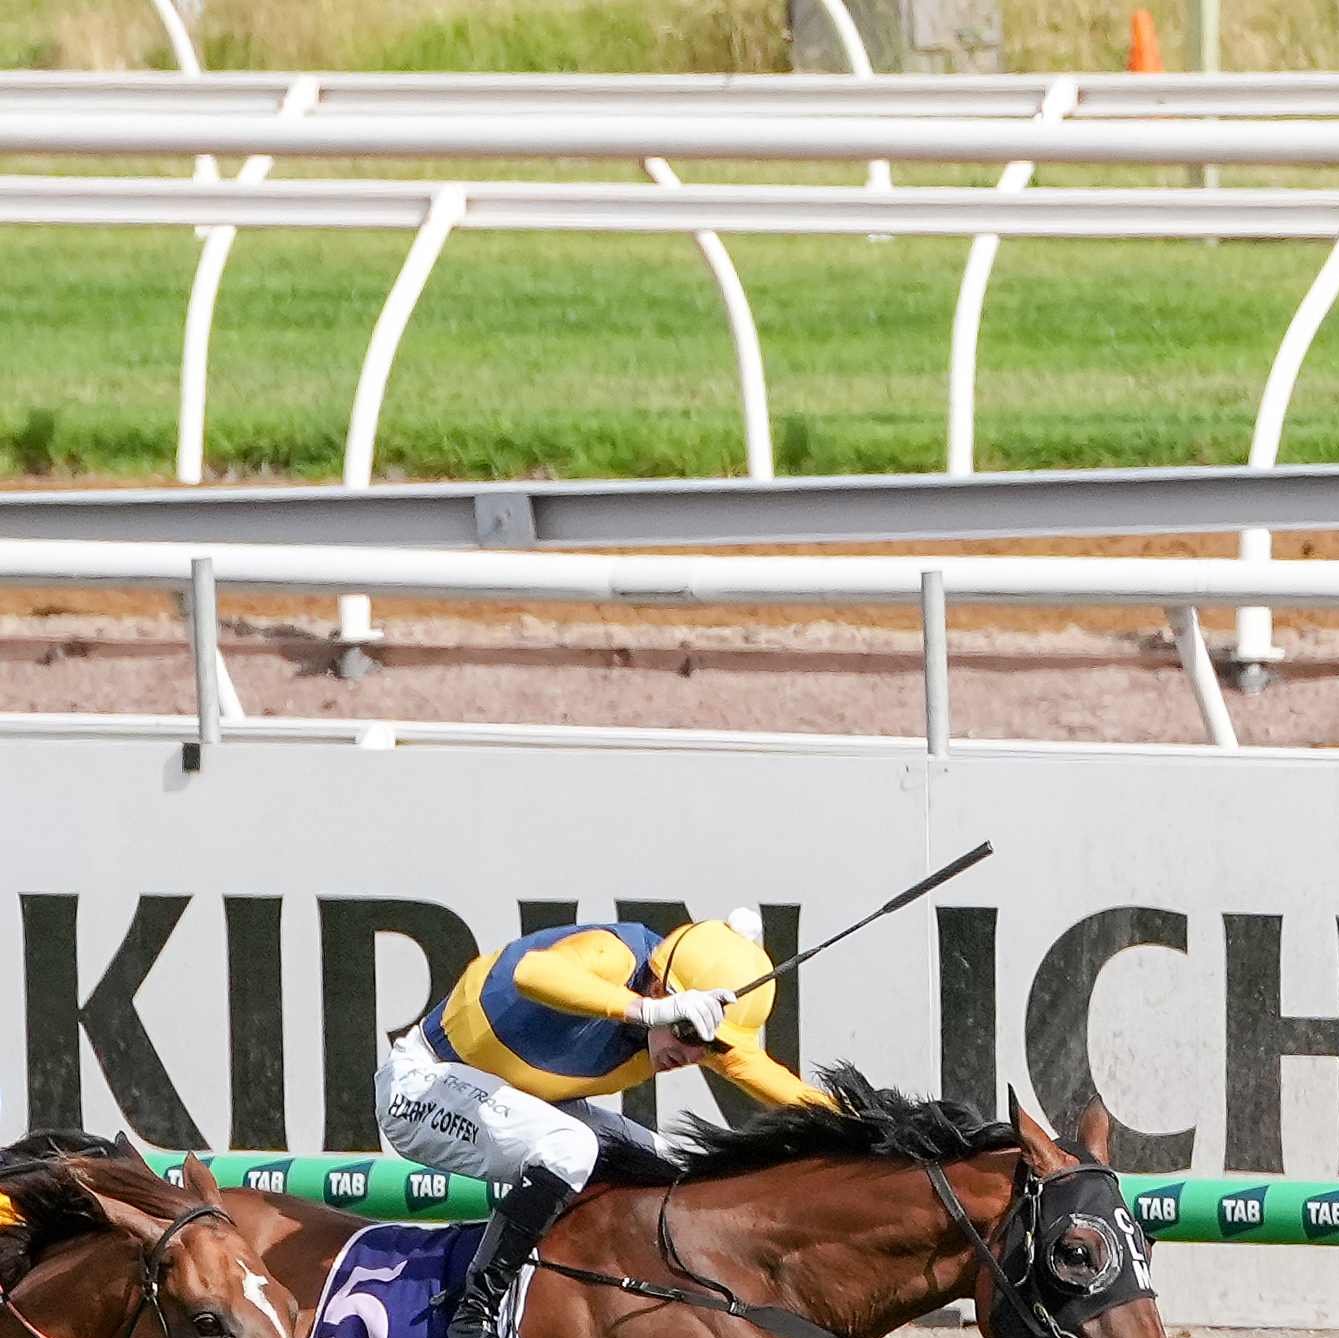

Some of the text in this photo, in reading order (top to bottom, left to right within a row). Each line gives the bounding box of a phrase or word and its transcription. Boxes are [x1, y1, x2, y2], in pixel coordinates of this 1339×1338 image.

[18, 891, 802, 1153] KIRN
[430, 1107, 480, 1145] COFFEY
[247, 1170, 285, 1194] TAB
[329, 1172, 366, 1198] TAB
[408, 1173, 447, 1199] TAB
[1137, 1197, 1177, 1221] TAB
[1221, 1199, 1261, 1223] TAB
